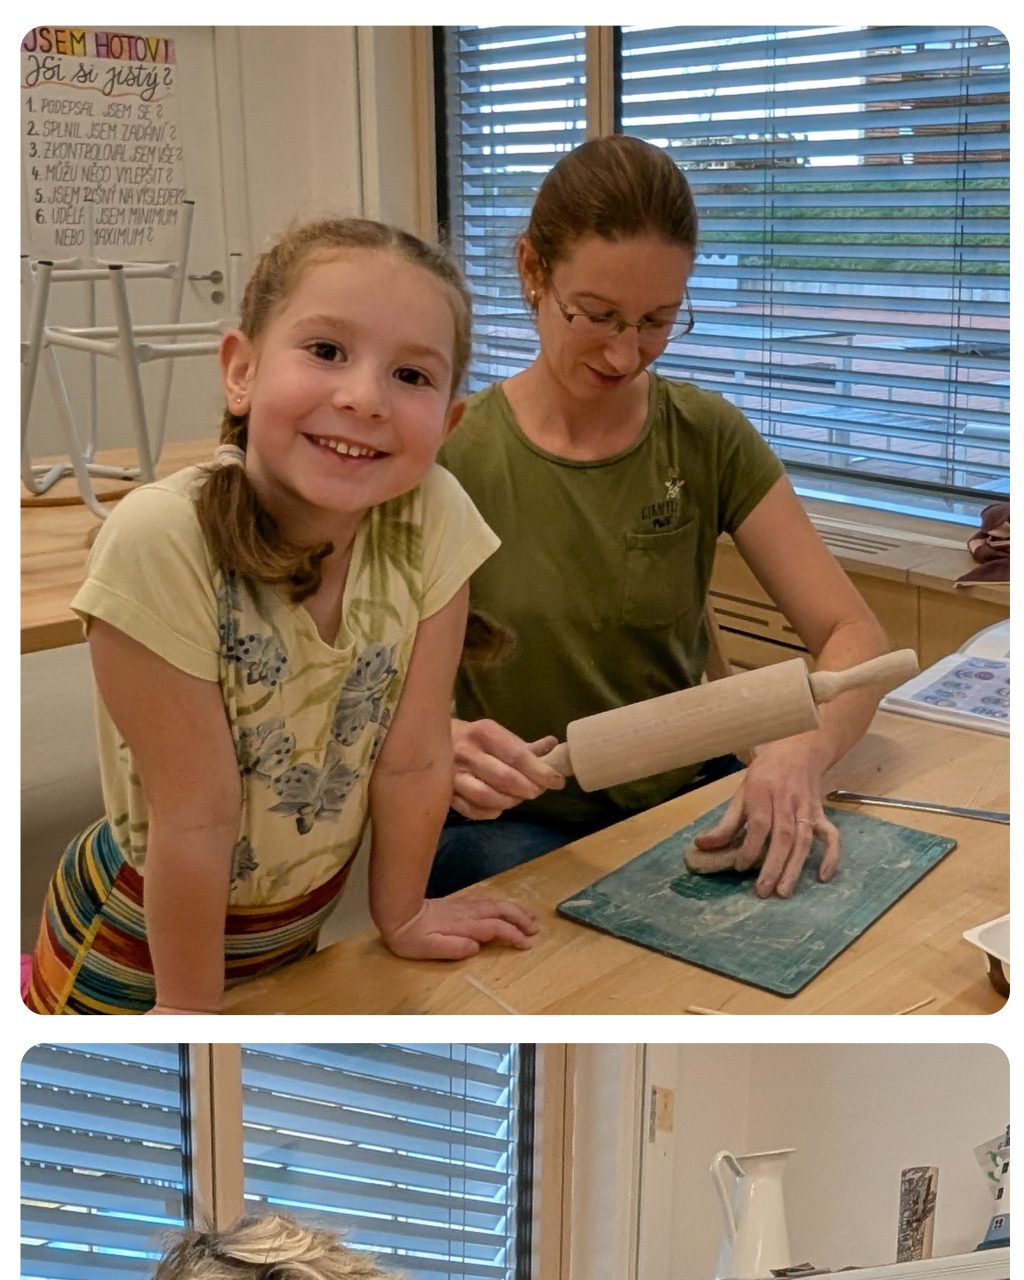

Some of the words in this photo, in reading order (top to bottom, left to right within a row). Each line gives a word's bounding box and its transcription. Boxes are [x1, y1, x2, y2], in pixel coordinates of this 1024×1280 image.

[23, 28, 87, 57] JSEM
[71, 62, 99, 83] si
[41, 98, 95, 117] PODEPSAL
[102, 102, 132, 119] JSEM
[42, 120, 82, 139] SPLNIL
[86, 121, 117, 140] JSEM
[43, 142, 128, 162] ZKONTROLOVAL
[129, 145, 156, 163] JSEM
[45, 161, 78, 182] MŮŽU
[81, 162, 111, 183] NĚCO
[48, 185, 81, 204] JSEM
[96, 207, 125, 225] JSEM
[129, 207, 178, 225] MINIMUM
[55, 228, 85, 246] NEBO
